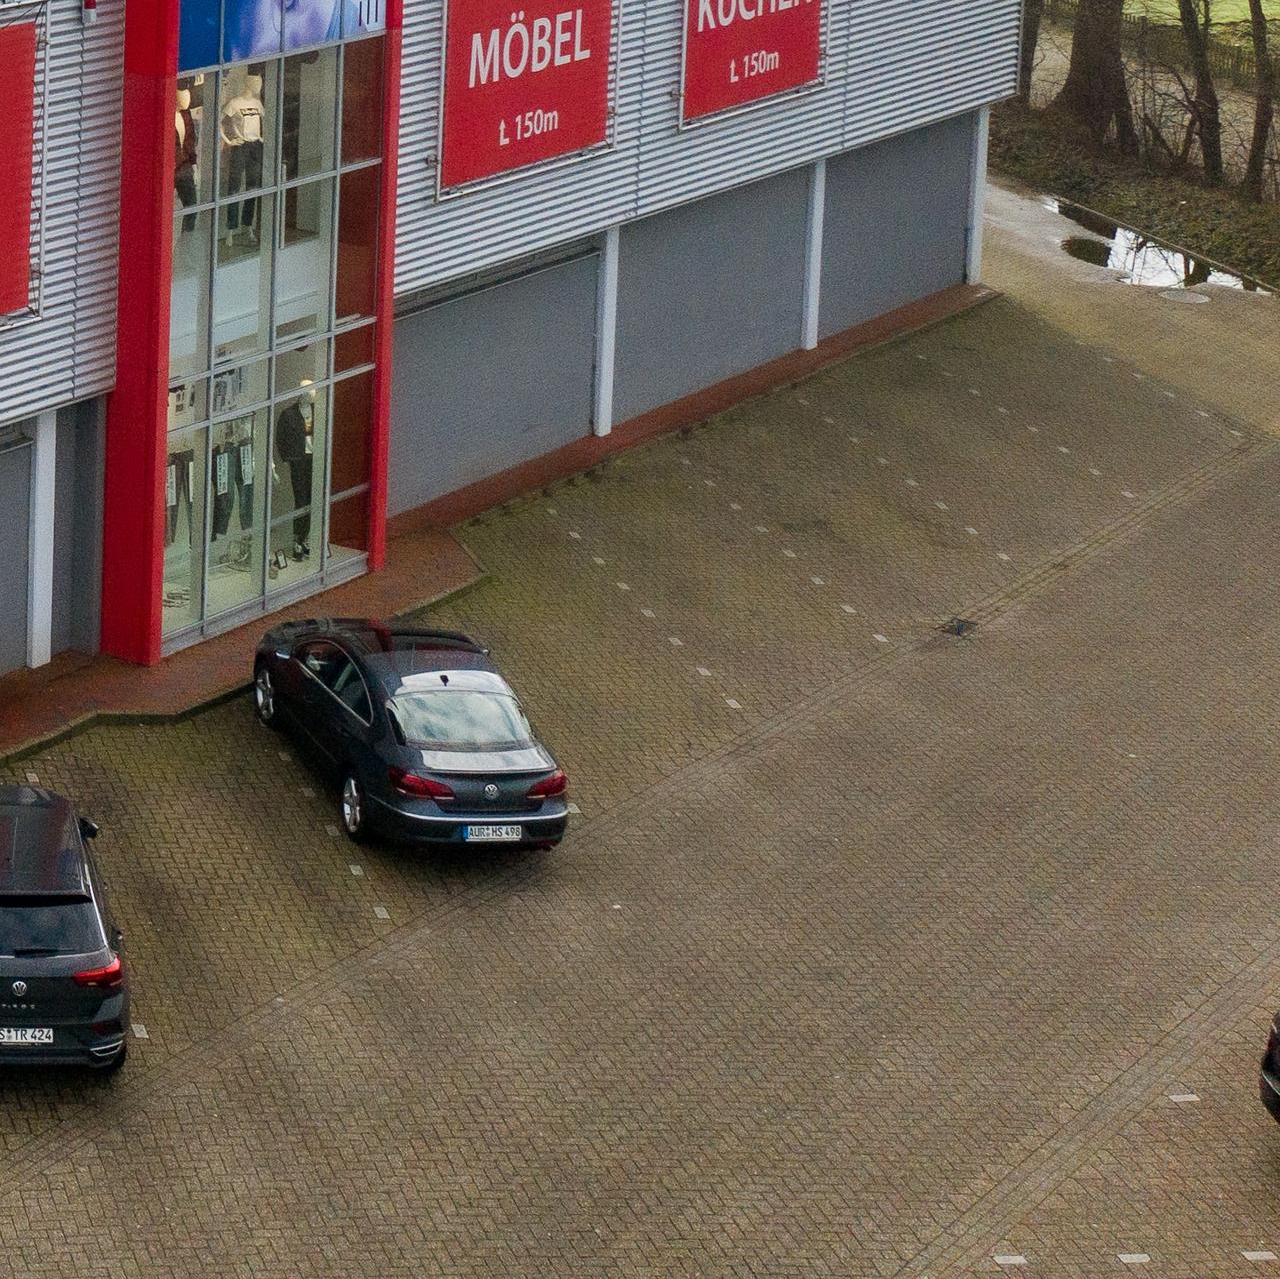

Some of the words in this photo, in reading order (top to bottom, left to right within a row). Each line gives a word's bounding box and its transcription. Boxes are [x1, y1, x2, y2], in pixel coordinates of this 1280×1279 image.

[468, 8, 591, 89] MÖBEL
[743, 50, 780, 78] 150m
[515, 108, 559, 141] 150m
[468, 826, 485, 838] AUR
[491, 826, 503, 838] HS
[13, 1029, 28, 1041] TR
[30, 1029, 52, 1041] 424
